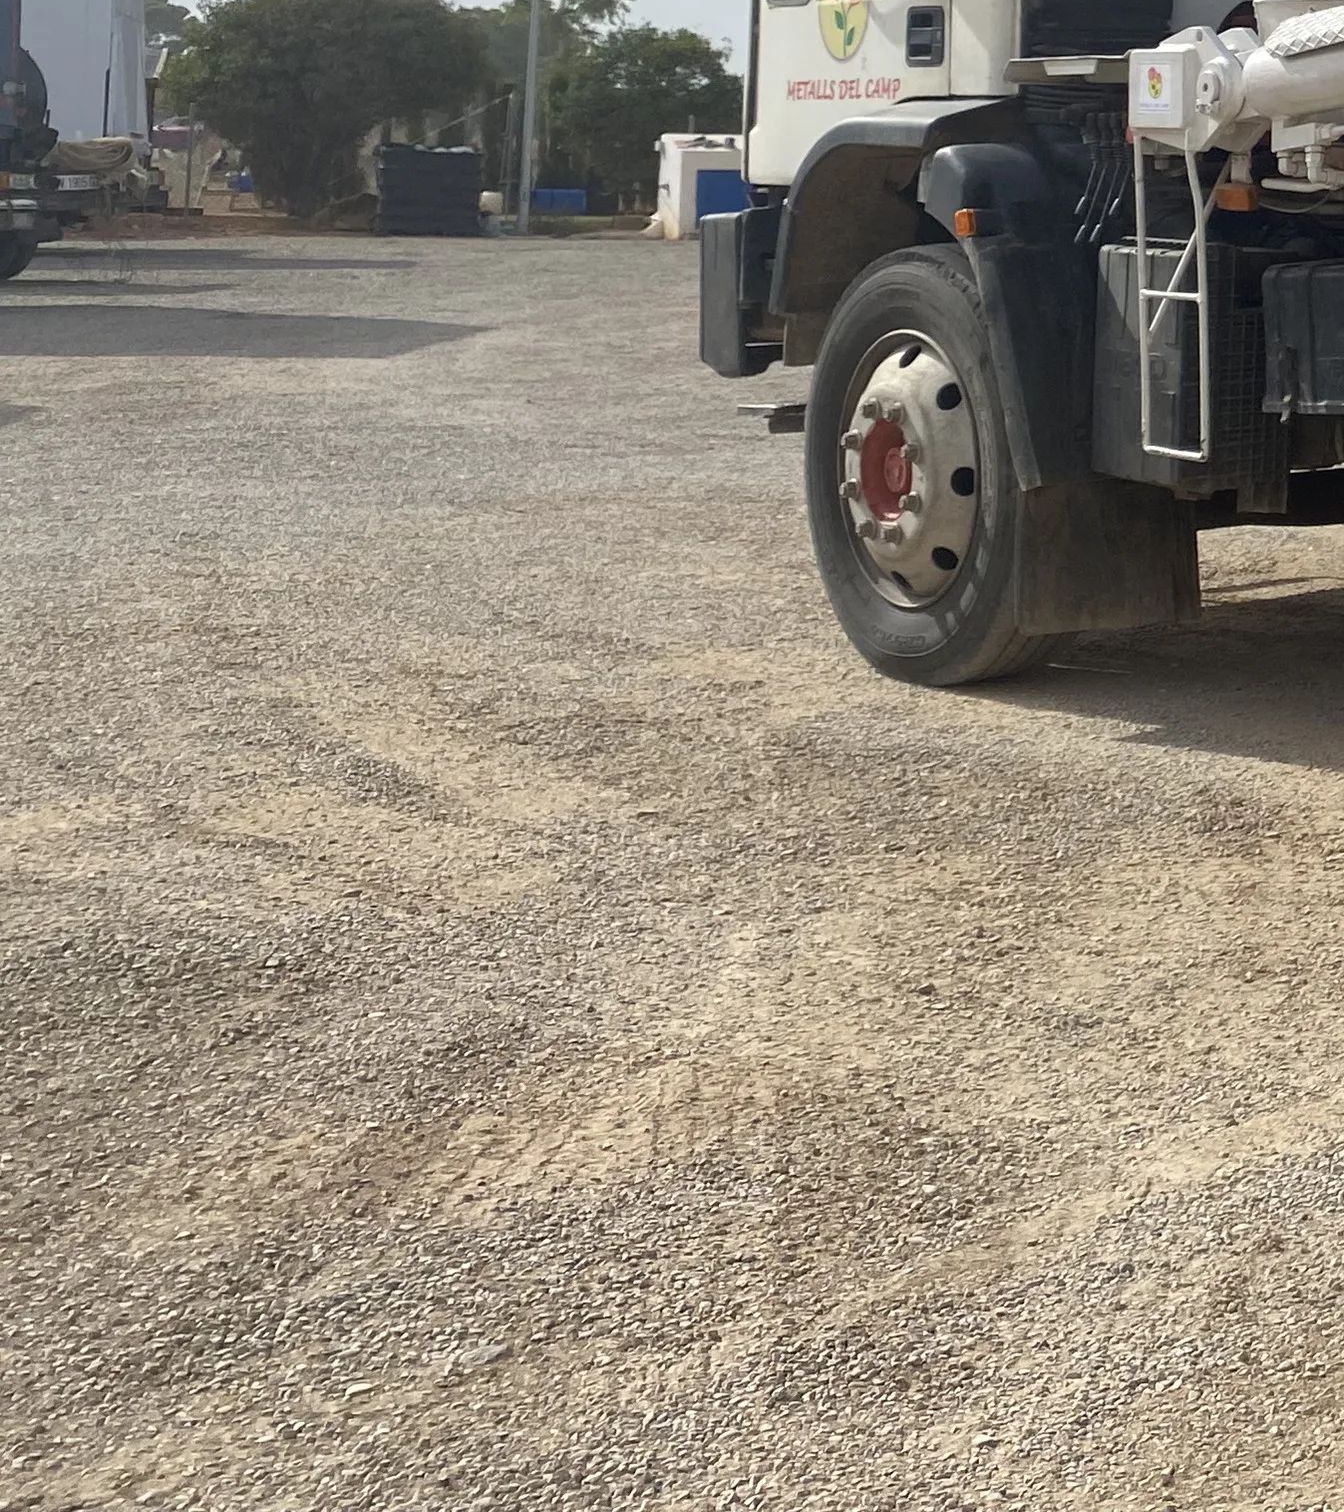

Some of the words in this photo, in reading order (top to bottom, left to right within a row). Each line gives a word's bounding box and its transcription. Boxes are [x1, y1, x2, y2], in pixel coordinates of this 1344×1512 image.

[787, 79, 836, 100] METALLS
[839, 78, 862, 100] DEL
[865, 78, 900, 99] CAMP
